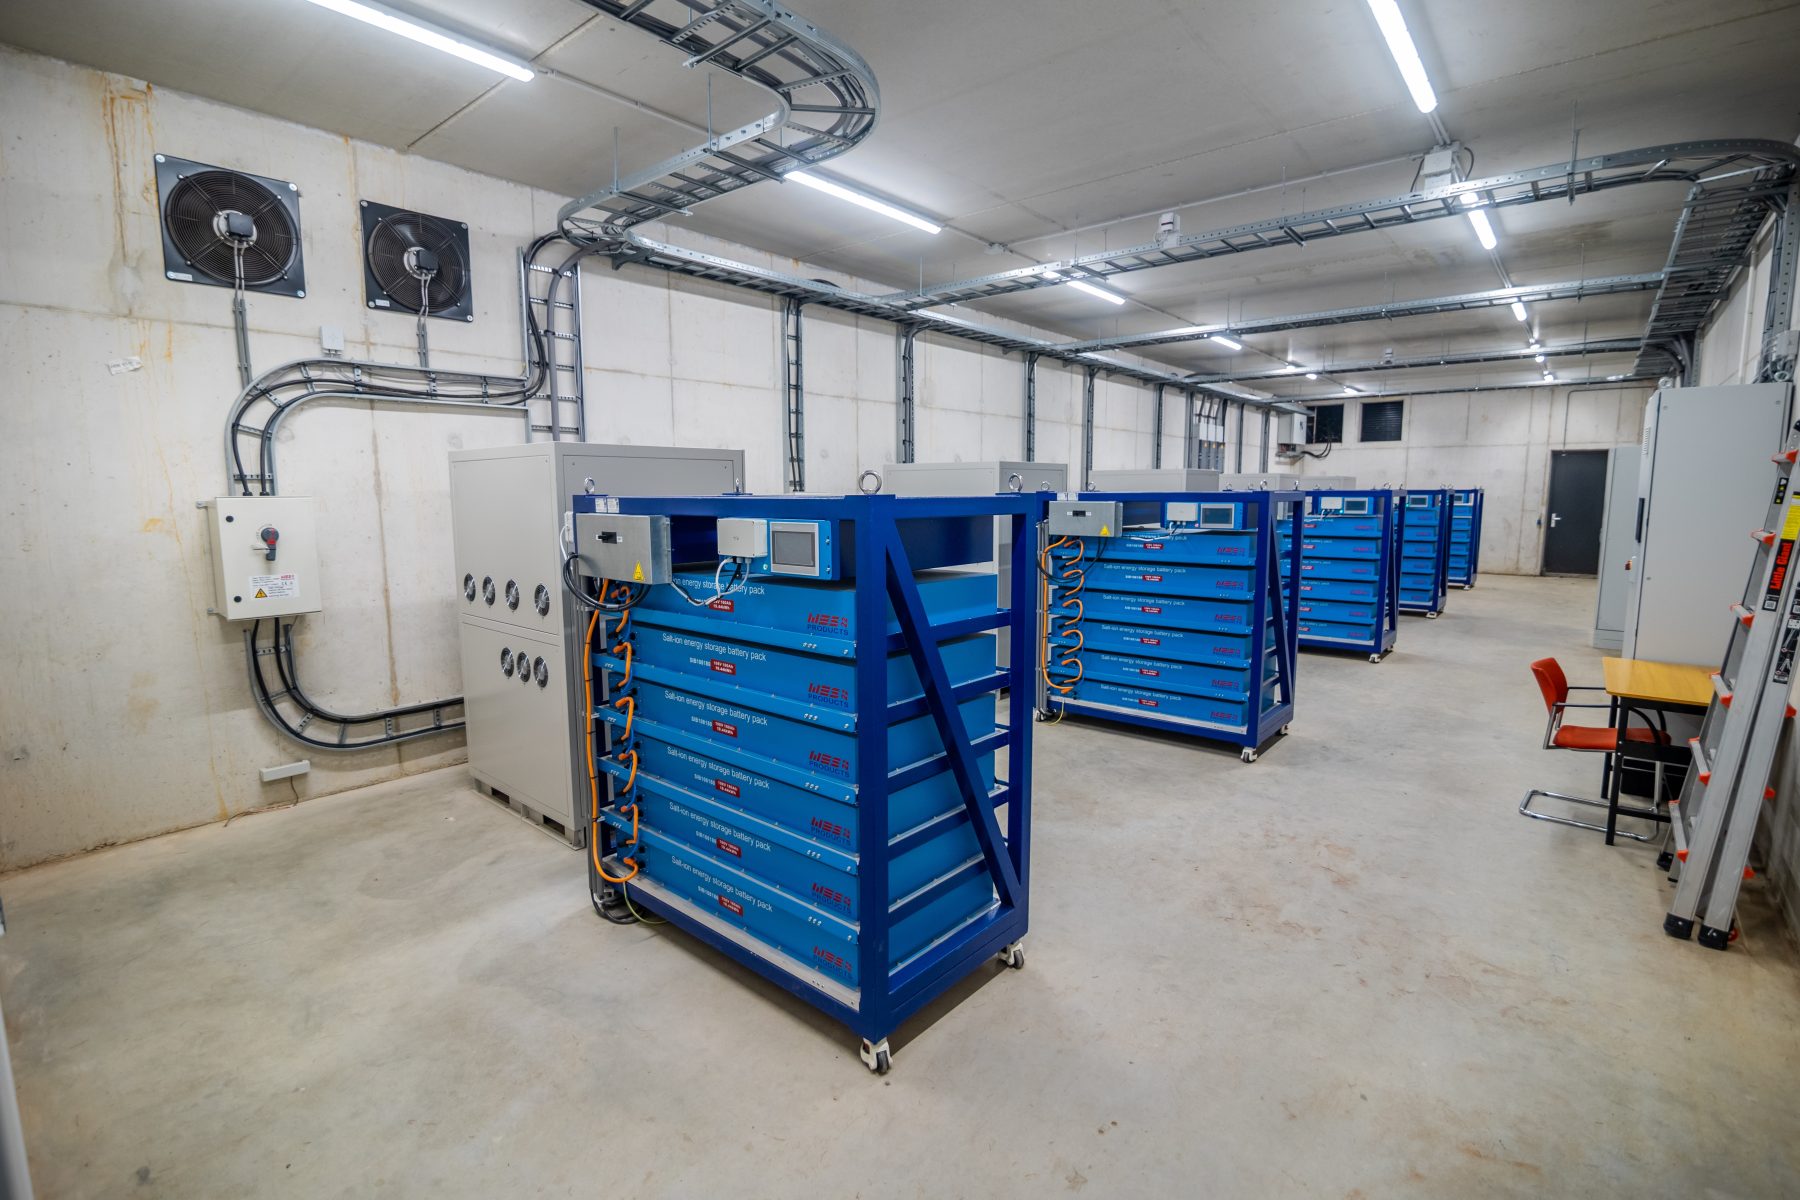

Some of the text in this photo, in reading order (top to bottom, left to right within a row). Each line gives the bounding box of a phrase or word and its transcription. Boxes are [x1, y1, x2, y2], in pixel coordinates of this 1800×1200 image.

[1776, 543, 1792, 564] Giant
[683, 579, 702, 590] energy
[702, 580, 724, 590] storae
[749, 586, 764, 595] pack
[1769, 567, 1786, 590] Little
[808, 624, 848, 636] PRODUCTS
[662, 632, 766, 662] Salt-ion energy storage battery pack
[665, 690, 768, 726] Salt-ion energy storage battery pack
[808, 694, 848, 708] PRODUCTS
[667, 746, 770, 789] Salt-ion energy storage battery pack
[670, 802, 689, 817] Salt-ion
[690, 812, 710, 827] energy
[710, 820, 732, 836] storage
[733, 829, 754, 845] battery
[756, 840, 772, 852] pack
[672, 856, 692, 872] Salt-ion
[693, 867, 711, 882] energy
[712, 876, 734, 892] storage
[735, 887, 756, 905] battery
[758, 900, 772, 912] pack
